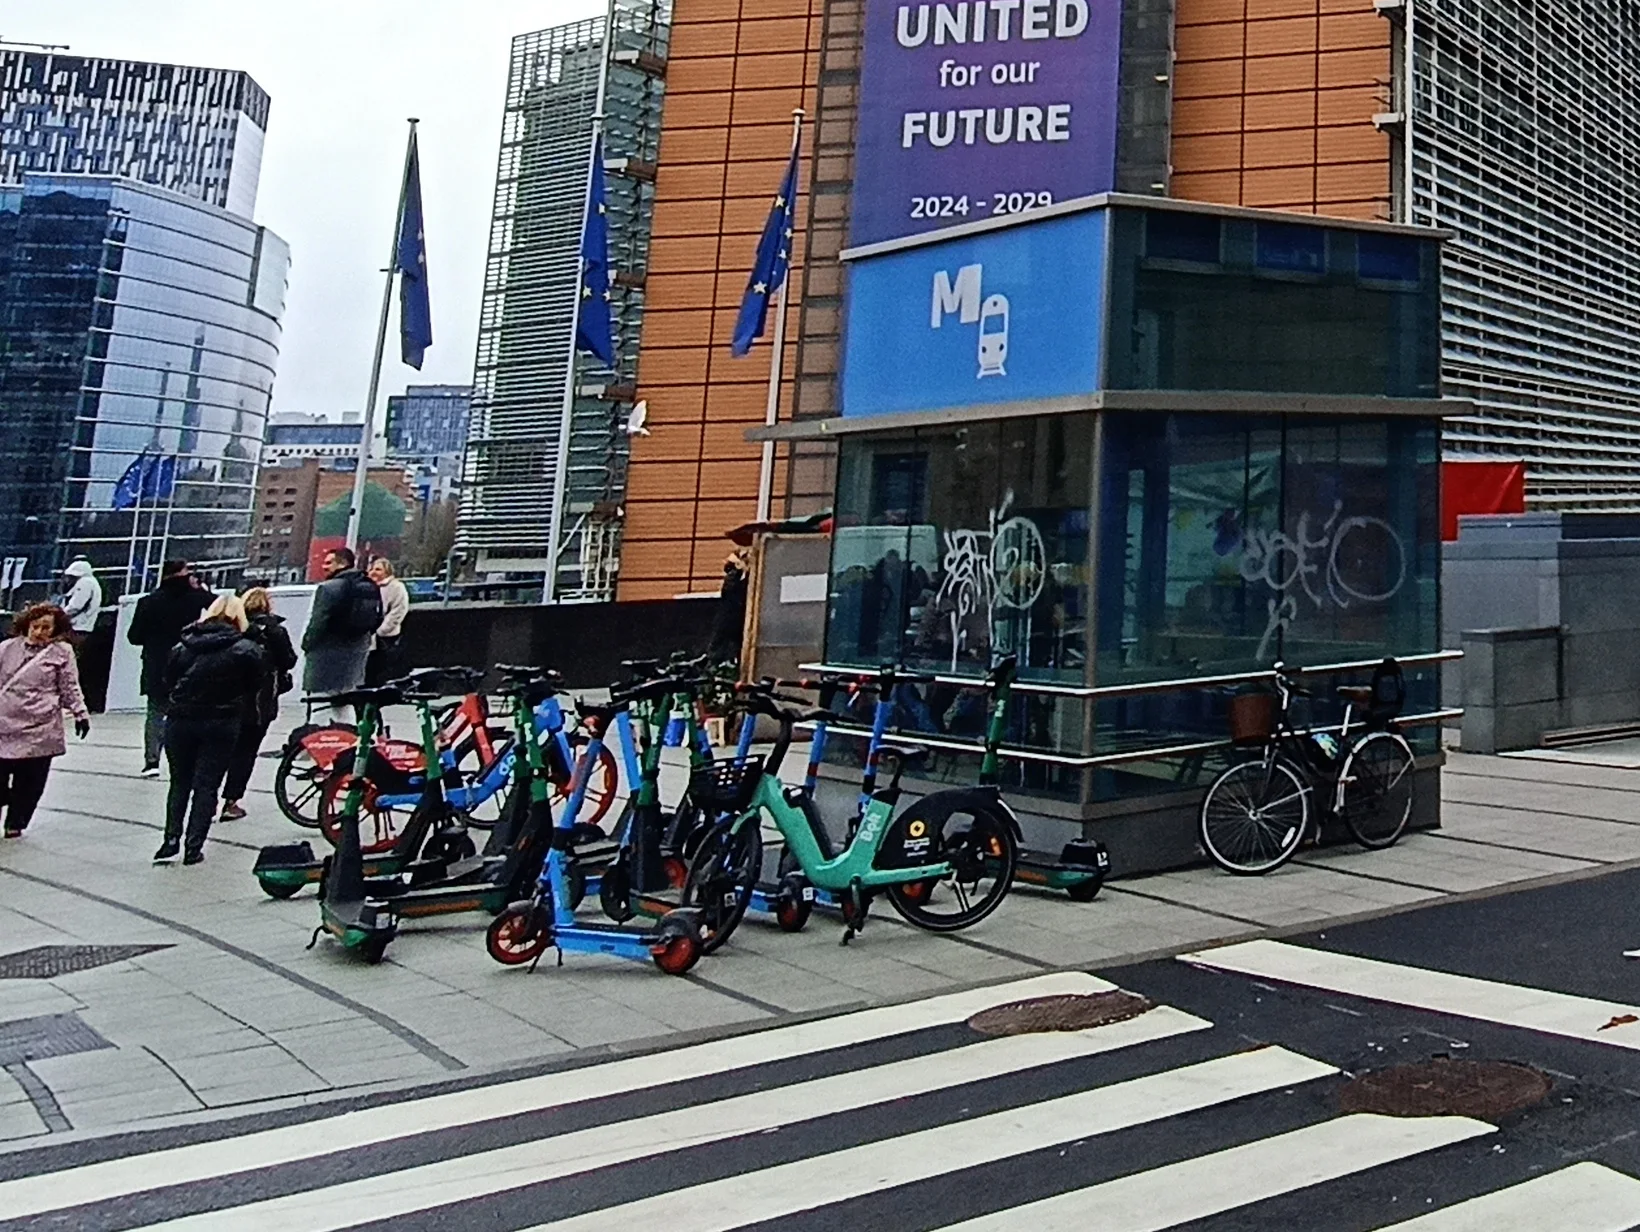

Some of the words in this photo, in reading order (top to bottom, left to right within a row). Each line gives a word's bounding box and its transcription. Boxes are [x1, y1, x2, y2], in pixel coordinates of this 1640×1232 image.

[940, 60, 982, 87] for
[991, 62, 1041, 84] our
[902, 104, 1071, 148] FUTURE
[911, 195, 969, 218] 2024
[993, 192, 1052, 214] 2029
[931, 263, 982, 328] M
